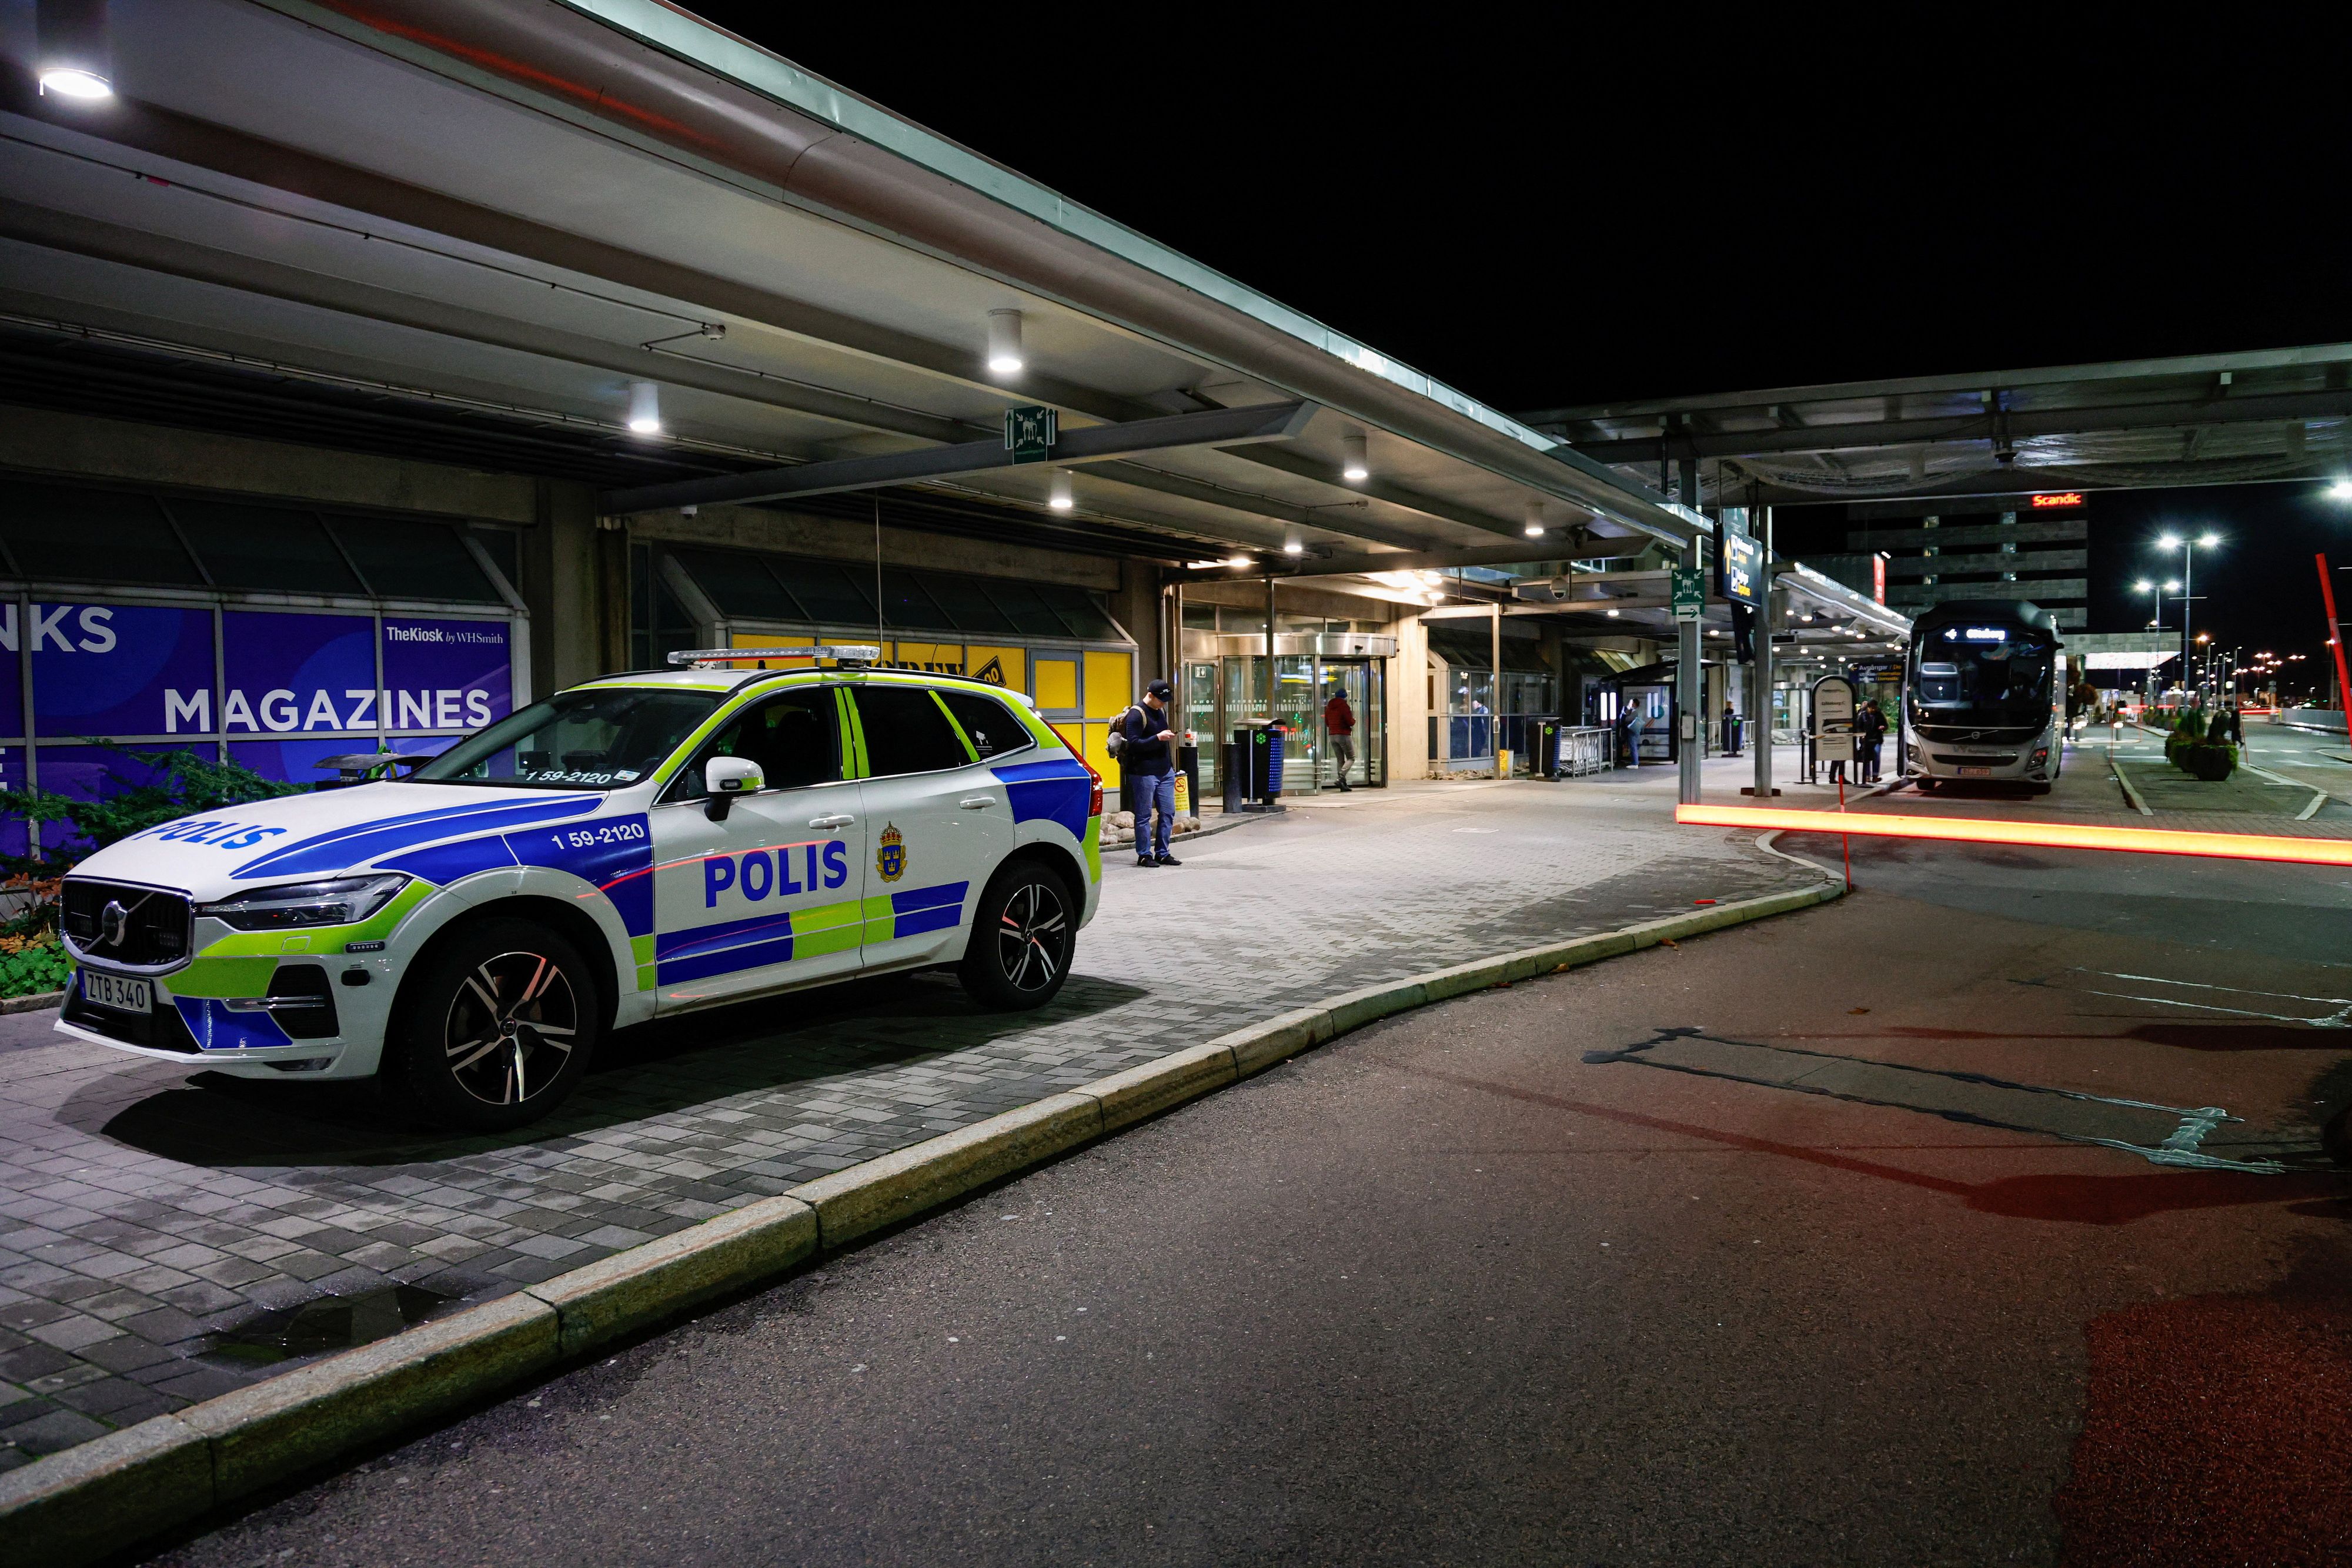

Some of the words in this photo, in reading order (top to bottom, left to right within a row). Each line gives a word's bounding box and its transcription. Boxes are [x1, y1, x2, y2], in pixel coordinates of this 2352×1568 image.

[2033, 493, 2081, 506] Scandic
[386, 627, 443, 642] TheKiosk
[446, 632, 455, 644] by
[456, 632, 503, 644] WHSmith
[165, 689, 492, 733] MAGAZINES
[526, 771, 537, 781] 1
[539, 771, 612, 784] 59-2120
[131, 821, 288, 850] POLIS
[551, 835, 564, 850] 1
[568, 823, 644, 847] 59-2120
[704, 840, 847, 908] POLIS
[88, 974, 113, 1002] ZTB
[116, 980, 144, 1008] 340
